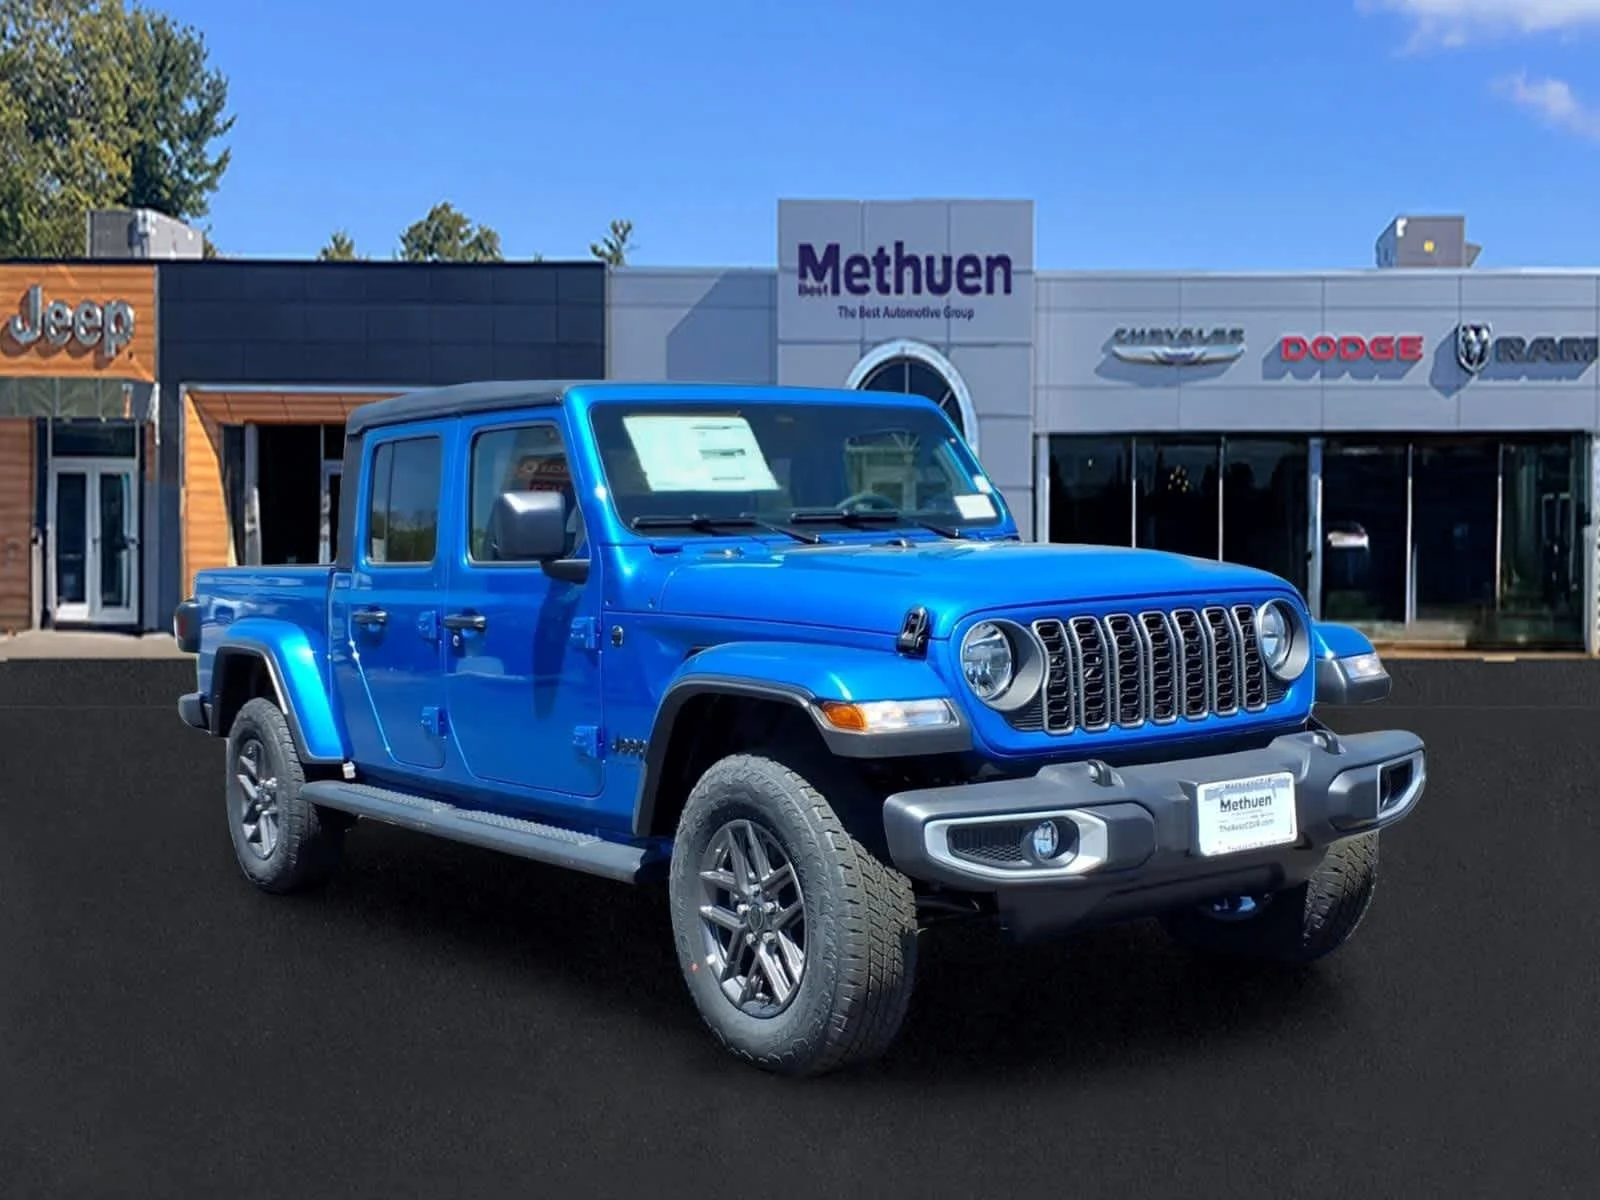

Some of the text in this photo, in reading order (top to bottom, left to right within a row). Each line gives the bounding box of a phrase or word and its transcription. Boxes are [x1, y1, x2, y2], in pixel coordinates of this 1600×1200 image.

[798, 241, 1012, 296] Methuen
[10, 284, 135, 357] Jeep
[838, 304, 974, 321] The Best Automotive Group
[1280, 335, 1424, 362] DODGE
[1495, 336, 1598, 363] RAM
[1220, 795, 1272, 812] Methuen
